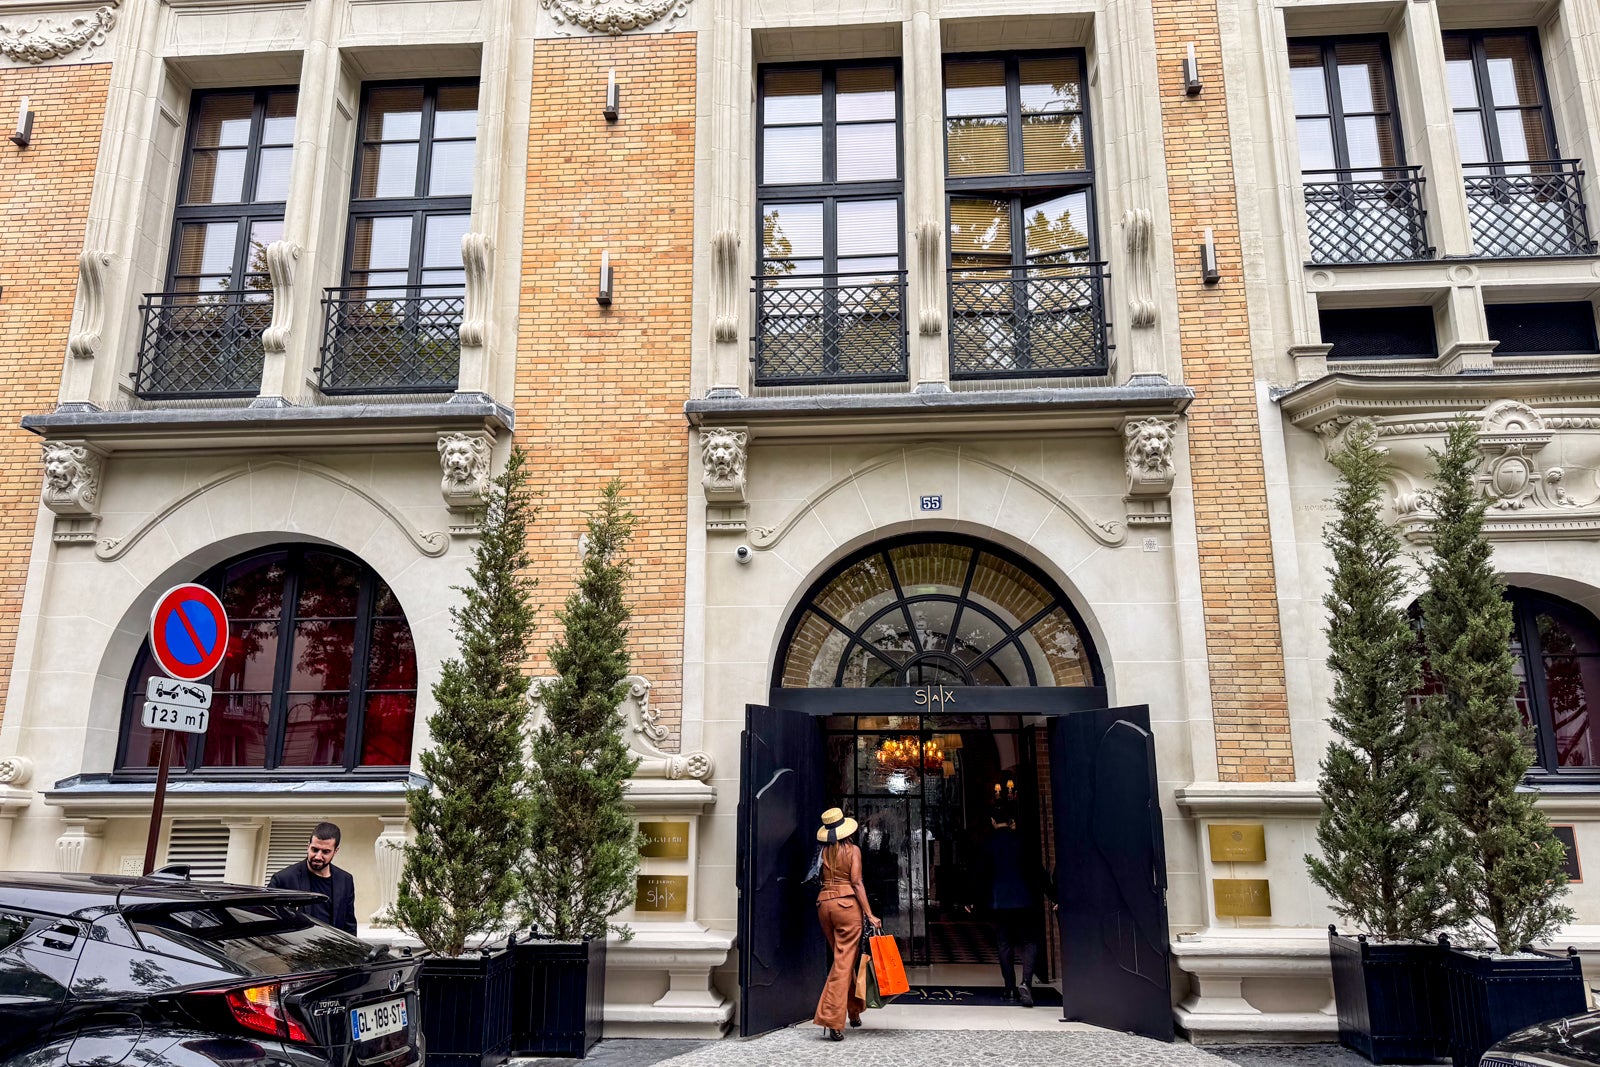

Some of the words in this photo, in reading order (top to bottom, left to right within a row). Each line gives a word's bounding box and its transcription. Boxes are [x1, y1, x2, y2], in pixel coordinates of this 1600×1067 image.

[923, 497, 940, 509] 55
[159, 708, 178, 723] 23
[184, 715, 196, 725] m
[319, 1000, 341, 1008] TOYOTA
[313, 1006, 346, 1016] C-HR
